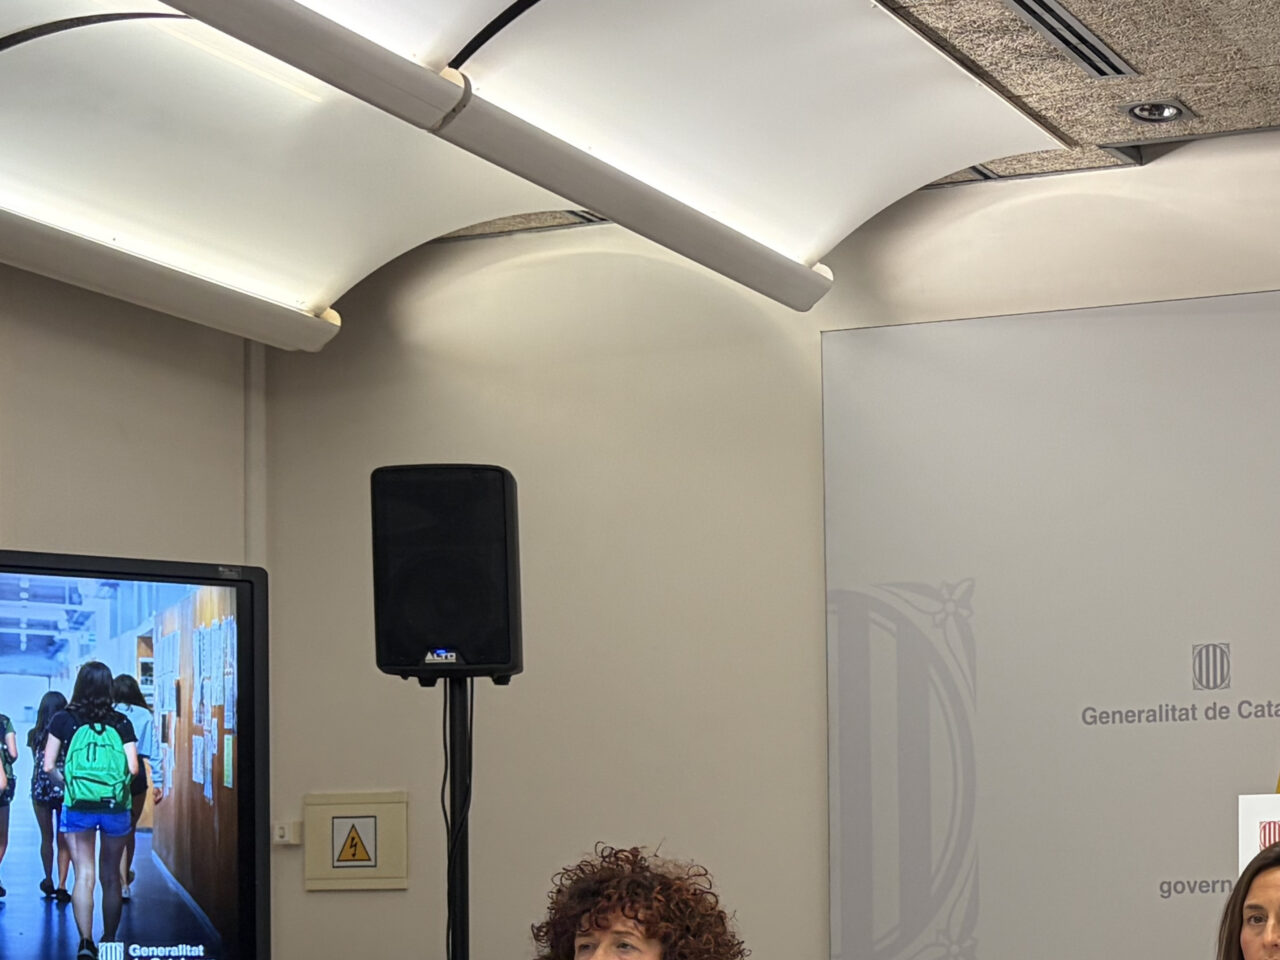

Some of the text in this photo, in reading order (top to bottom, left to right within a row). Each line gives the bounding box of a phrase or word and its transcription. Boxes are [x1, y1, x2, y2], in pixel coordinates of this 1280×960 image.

[425, 652, 456, 660] ALTO
[1081, 704, 1198, 725] Generalitat
[1204, 702, 1230, 720] de
[1159, 878, 1233, 899] govern
[128, 943, 205, 957] Generalitat
